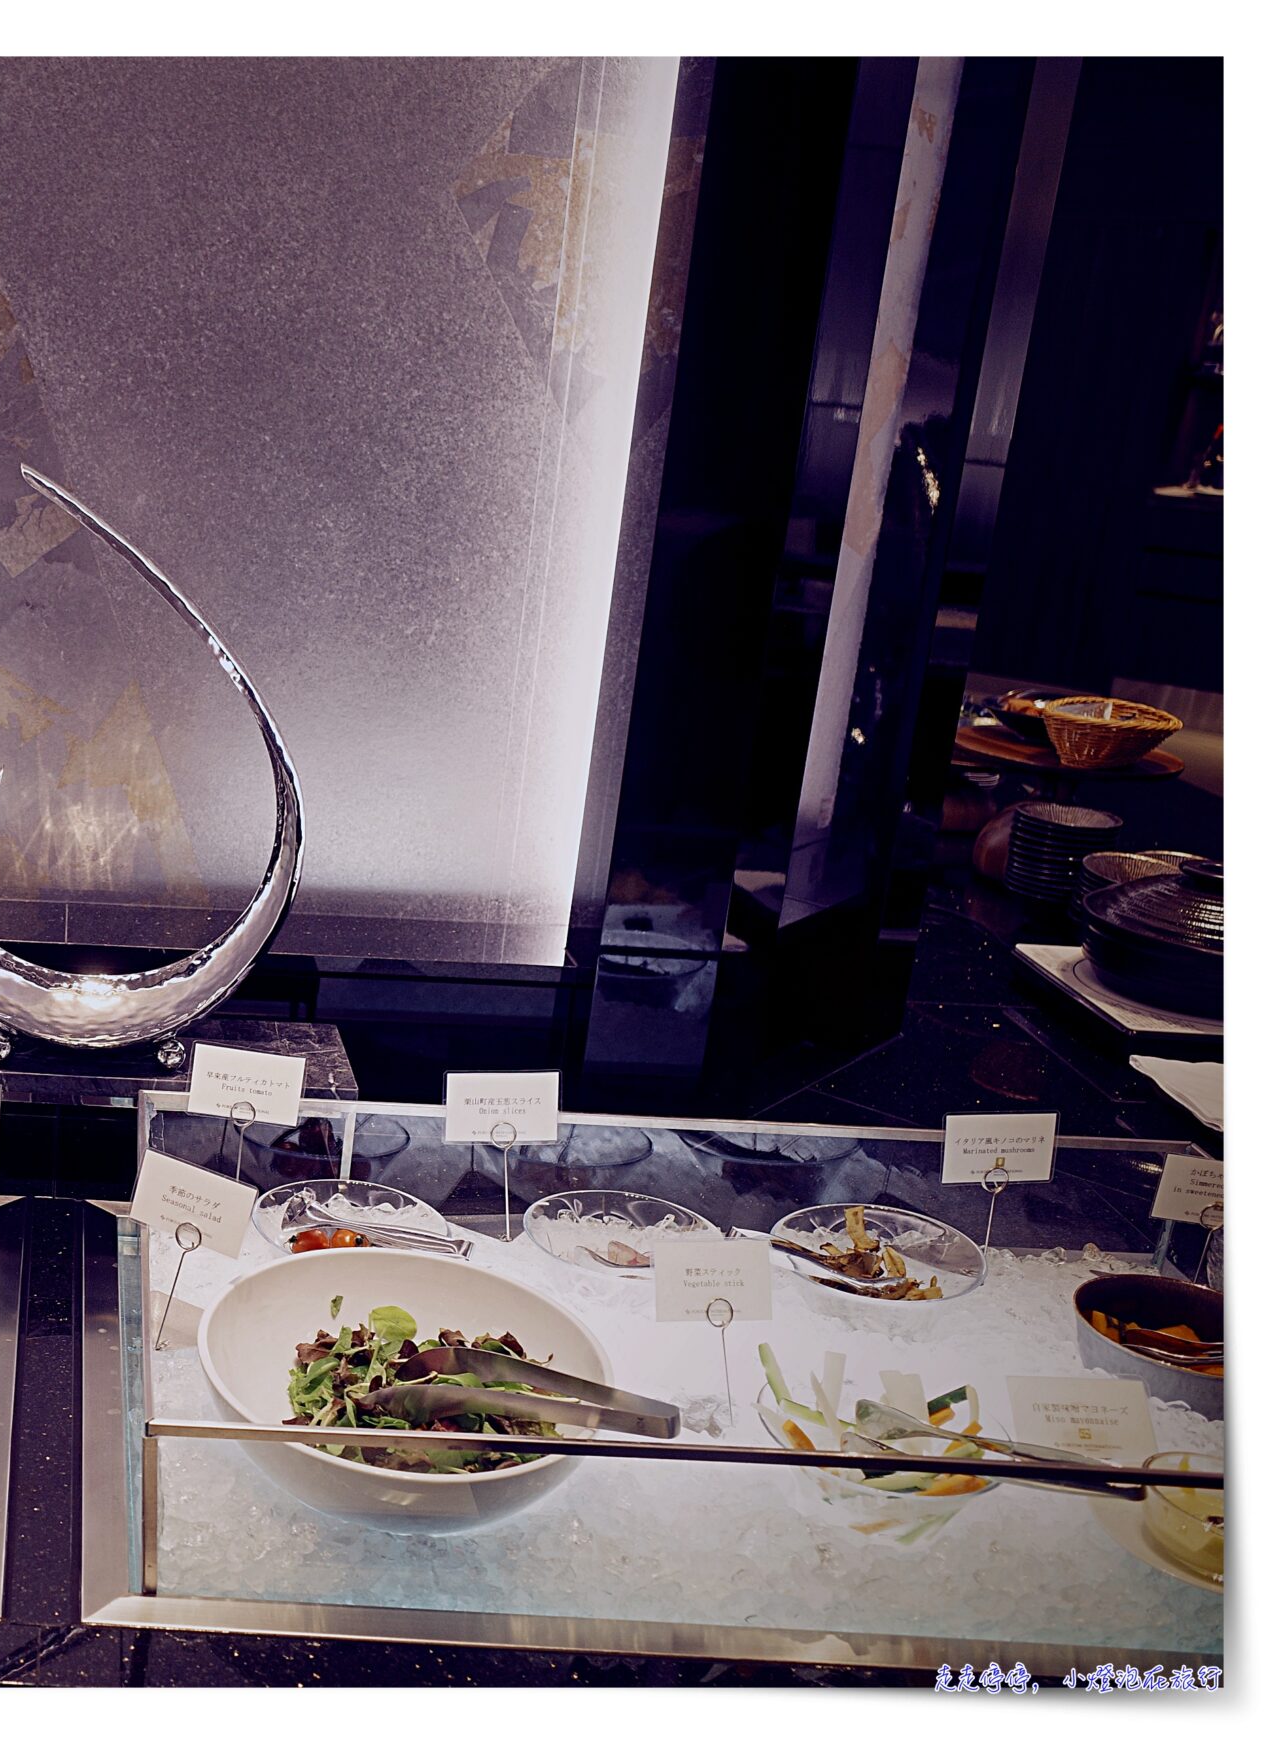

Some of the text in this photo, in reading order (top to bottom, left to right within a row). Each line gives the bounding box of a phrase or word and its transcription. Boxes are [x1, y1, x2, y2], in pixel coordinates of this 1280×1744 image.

[221, 1083, 273, 1097] Fruits tomato
[479, 1107, 526, 1115] Onion slices
[963, 1146, 1035, 1155] Marinated mushrooms
[169, 1185, 221, 1209] 季節のサラダ
[161, 1194, 223, 1224] Seasonal salad
[685, 1268, 741, 1277] 野菜スティック
[683, 1280, 720, 1288] Vegetable
